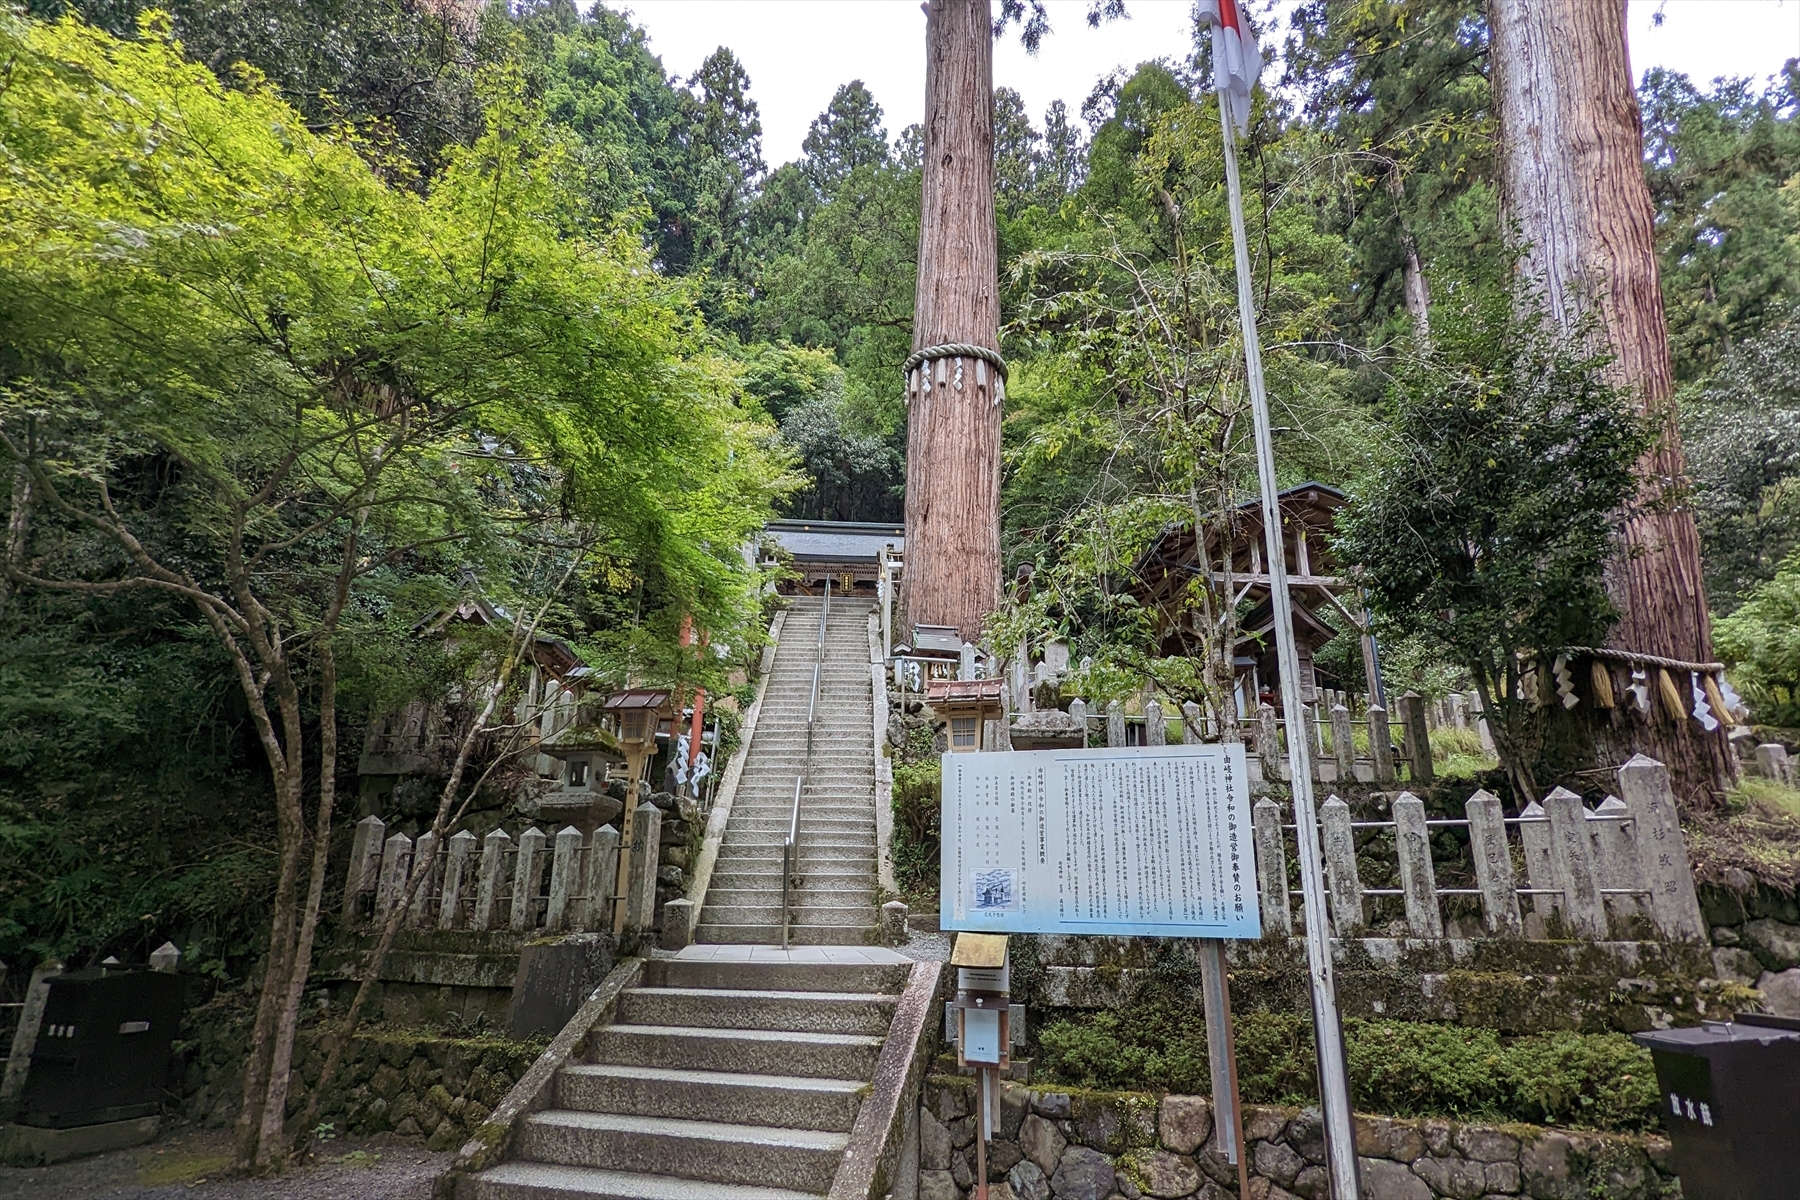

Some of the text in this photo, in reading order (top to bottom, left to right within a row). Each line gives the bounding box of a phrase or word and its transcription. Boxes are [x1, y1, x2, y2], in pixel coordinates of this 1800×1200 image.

[1223, 755, 1245, 921] 由岐神社令和の御造営御奉賛のお願い
